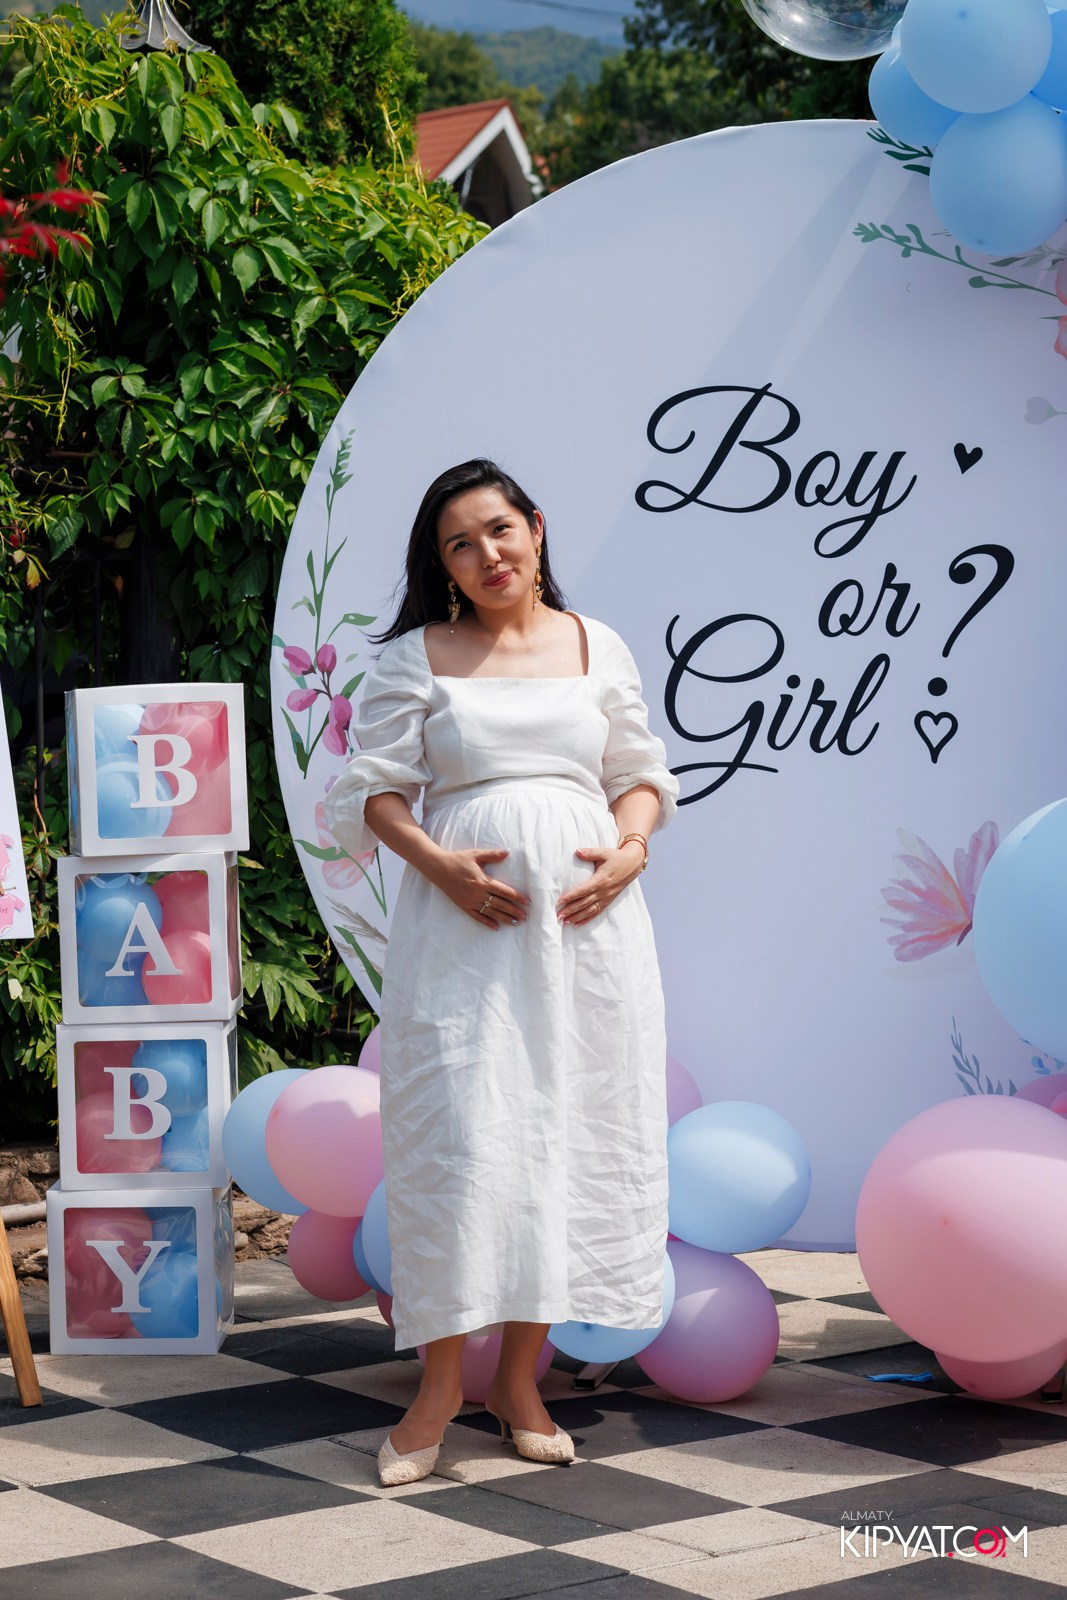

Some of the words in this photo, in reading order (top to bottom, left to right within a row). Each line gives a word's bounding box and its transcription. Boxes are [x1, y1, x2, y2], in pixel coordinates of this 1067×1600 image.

[634, 382, 918, 559] Boy
[818, 562, 921, 638] or
[664, 613, 891, 807] Girl
[127, 733, 198, 809] B
[105, 902, 184, 977] A
[103, 1066, 172, 1141] B
[85, 1240, 172, 1313] Y
